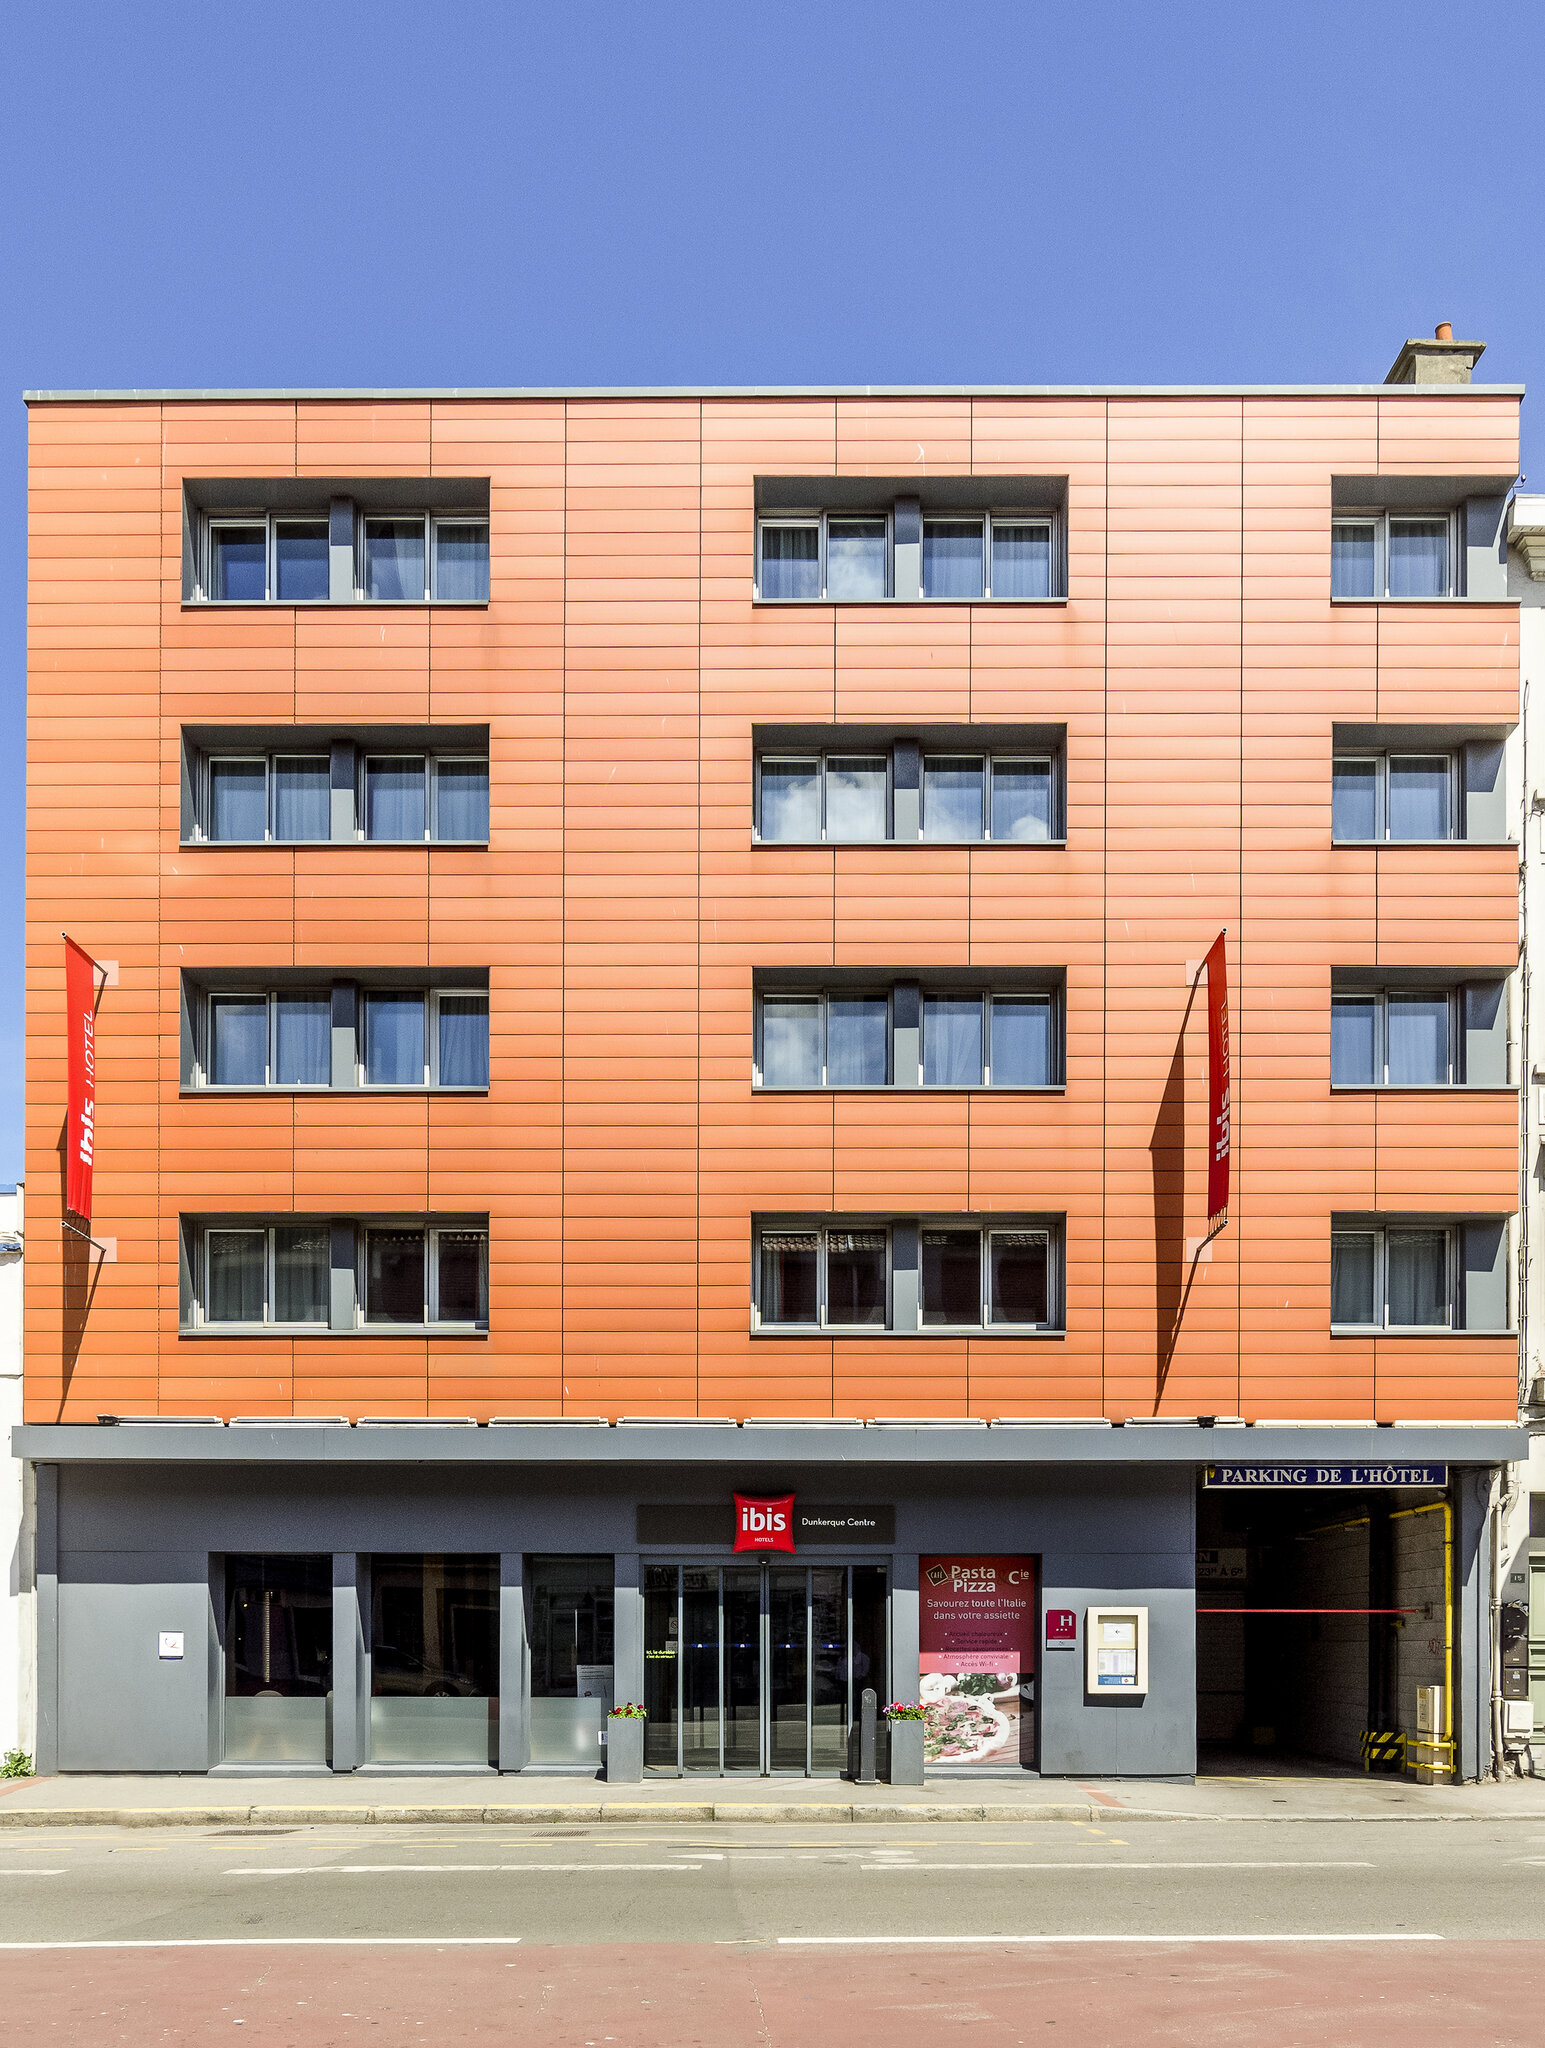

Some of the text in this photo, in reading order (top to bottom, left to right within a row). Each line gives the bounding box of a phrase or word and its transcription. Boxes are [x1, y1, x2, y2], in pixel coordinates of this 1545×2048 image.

[1215, 992, 1230, 1162] ibis HOTEL
[80, 1009, 95, 1166] ibis HOTEL
[1221, 1465, 1434, 1483] PARKING DE L'HÔTEL
[742, 1507, 786, 1531] ibis
[802, 1517, 876, 1528] Dunkerque Centre
[951, 1565, 996, 1579] Pasta
[1008, 1569, 1029, 1585] Cie
[953, 1579, 996, 1593] Pizza
[927, 1598, 1027, 1608] Savourez toute l'Italie
[933, 1610, 1020, 1620] dans votre assiette
[1060, 1615, 1072, 1627] H
